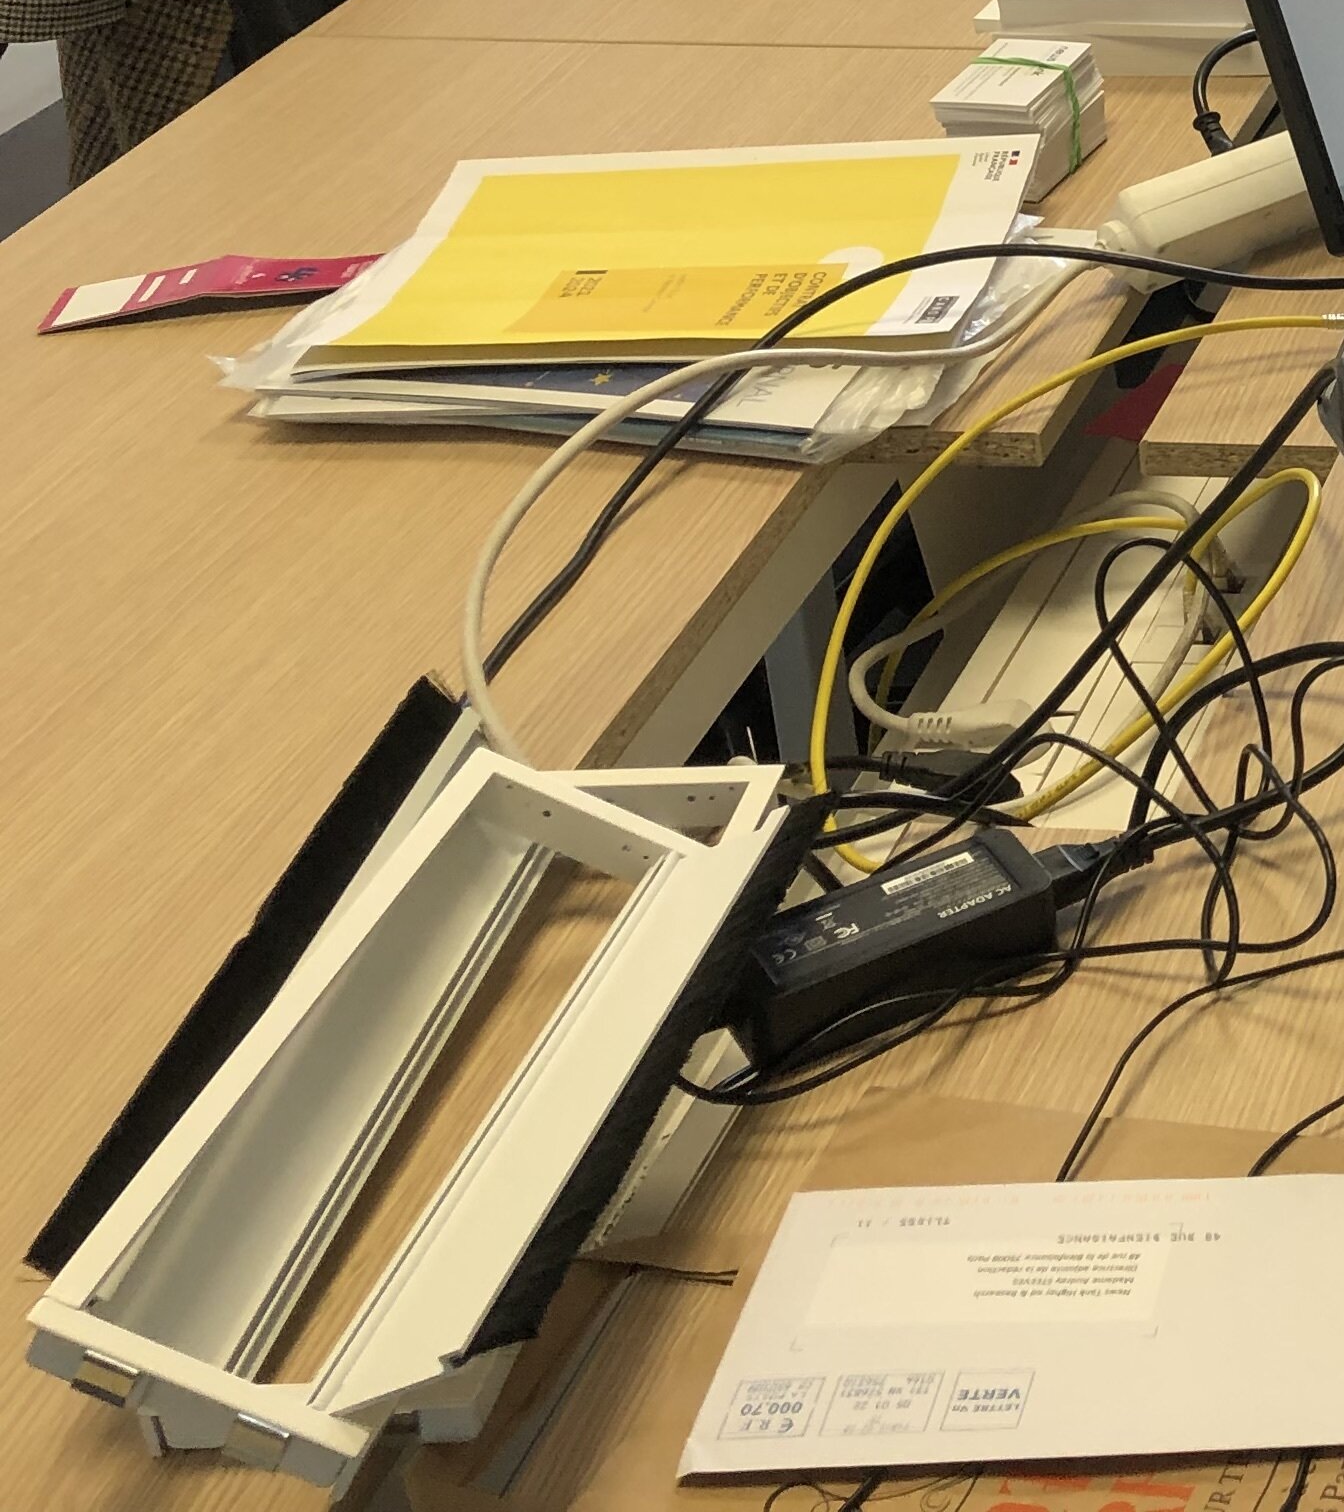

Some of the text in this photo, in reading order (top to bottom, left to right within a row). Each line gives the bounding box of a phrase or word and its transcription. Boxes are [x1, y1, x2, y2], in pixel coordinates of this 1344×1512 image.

[791, 271, 827, 309] CONTRA
[714, 272, 769, 327] PERFORMANCE
[937, 883, 1012, 920] AC ADAPTER
[1054, 1276, 1091, 1286] Audrey
[1091, 1276, 1136, 1285] Madame
[956, 1387, 1022, 1402] VERTE
[738, 1400, 804, 1418] 000.70
[972, 1402, 1021, 1414] LETTRE
